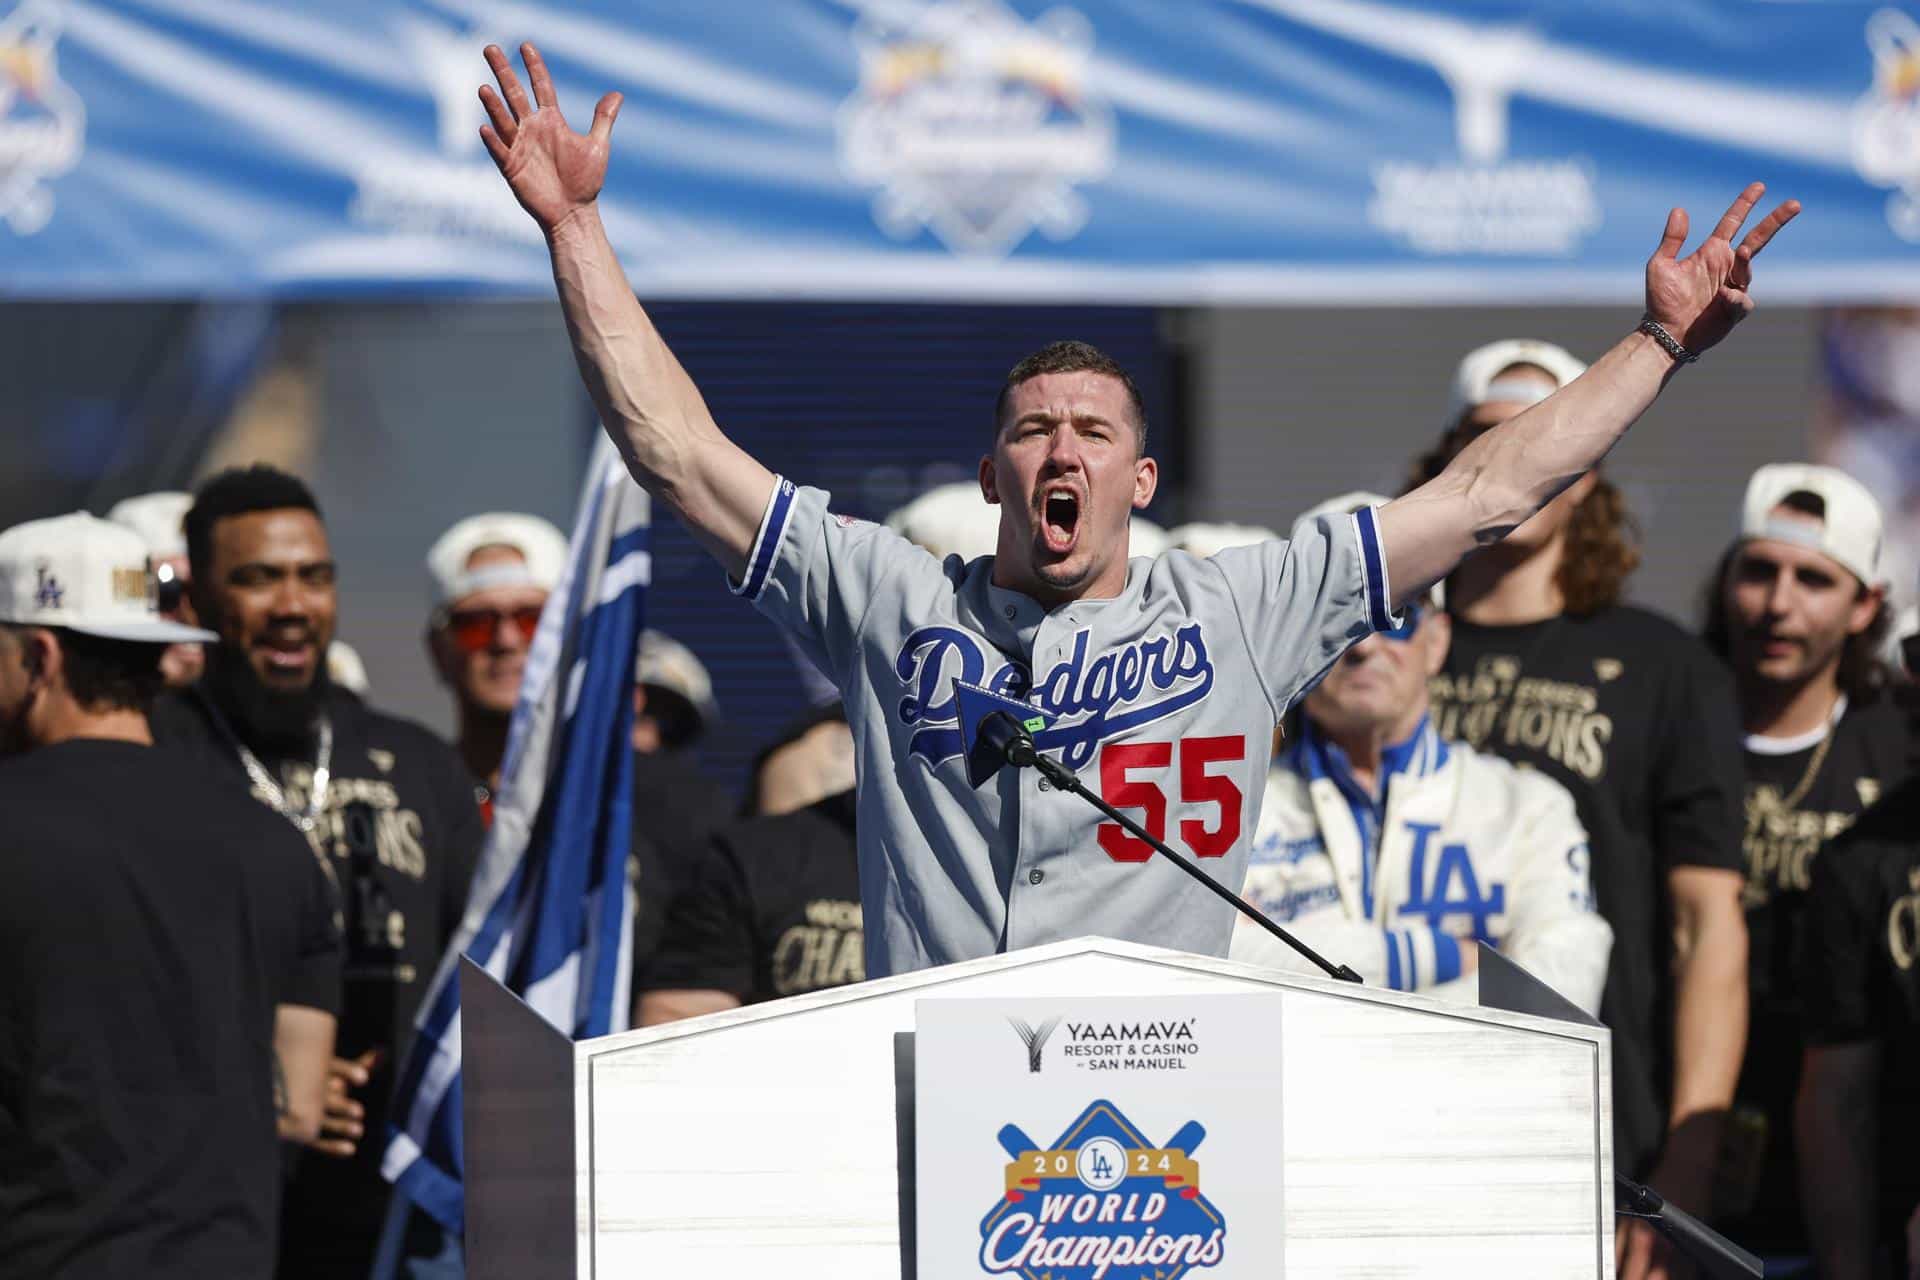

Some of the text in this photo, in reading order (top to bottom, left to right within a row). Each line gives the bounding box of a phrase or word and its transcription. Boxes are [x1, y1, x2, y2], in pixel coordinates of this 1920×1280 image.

[1097, 735, 1245, 862] 55
[1398, 822, 1505, 948] LA
[1064, 1043, 1199, 1057] RESORT & CASINO
[1089, 1059, 1119, 1071] SAN
[1124, 1057, 1187, 1070] MANUEL
[1091, 1148, 1113, 1180] LA
[1039, 1192, 1167, 1224] WORLD
[983, 1211, 1224, 1280] Champions
